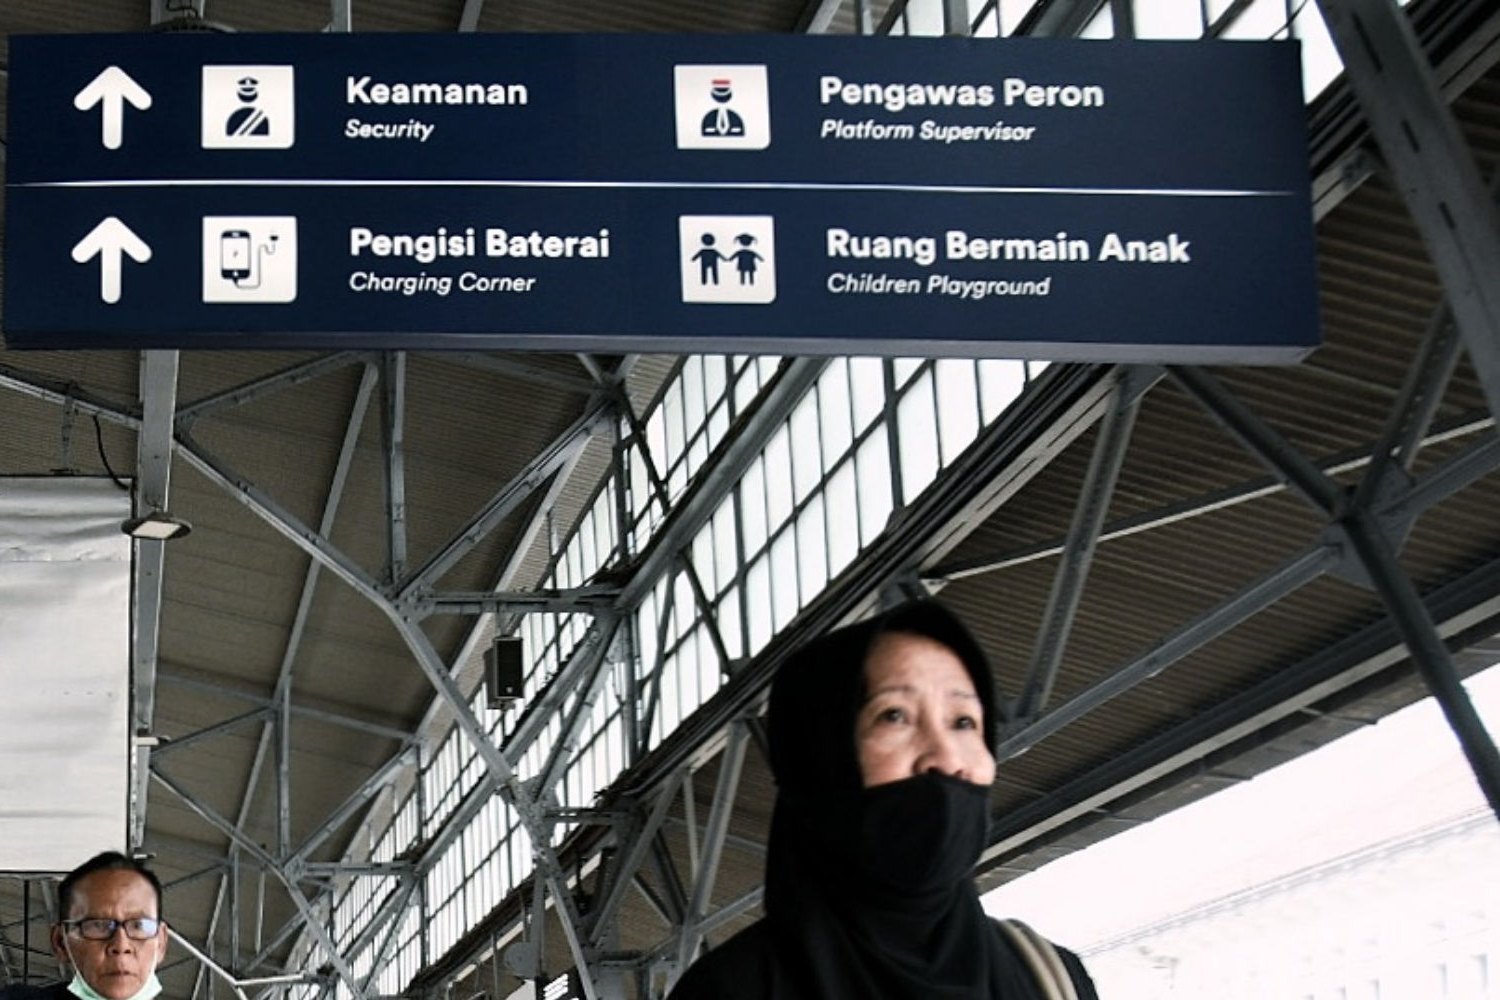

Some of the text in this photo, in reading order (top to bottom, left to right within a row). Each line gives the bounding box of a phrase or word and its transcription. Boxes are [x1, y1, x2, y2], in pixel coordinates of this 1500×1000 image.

[346, 76, 528, 105] Keamanan
[820, 76, 1105, 113] Pengawas Peron
[344, 118, 435, 143] Security
[820, 118, 1037, 145] Platform Supervisor
[350, 227, 610, 263] Pengisi Baterai
[826, 228, 1192, 266] Ruang Bermain Anak
[349, 271, 537, 297] Charging Corner
[826, 272, 1052, 301] Children Playground
